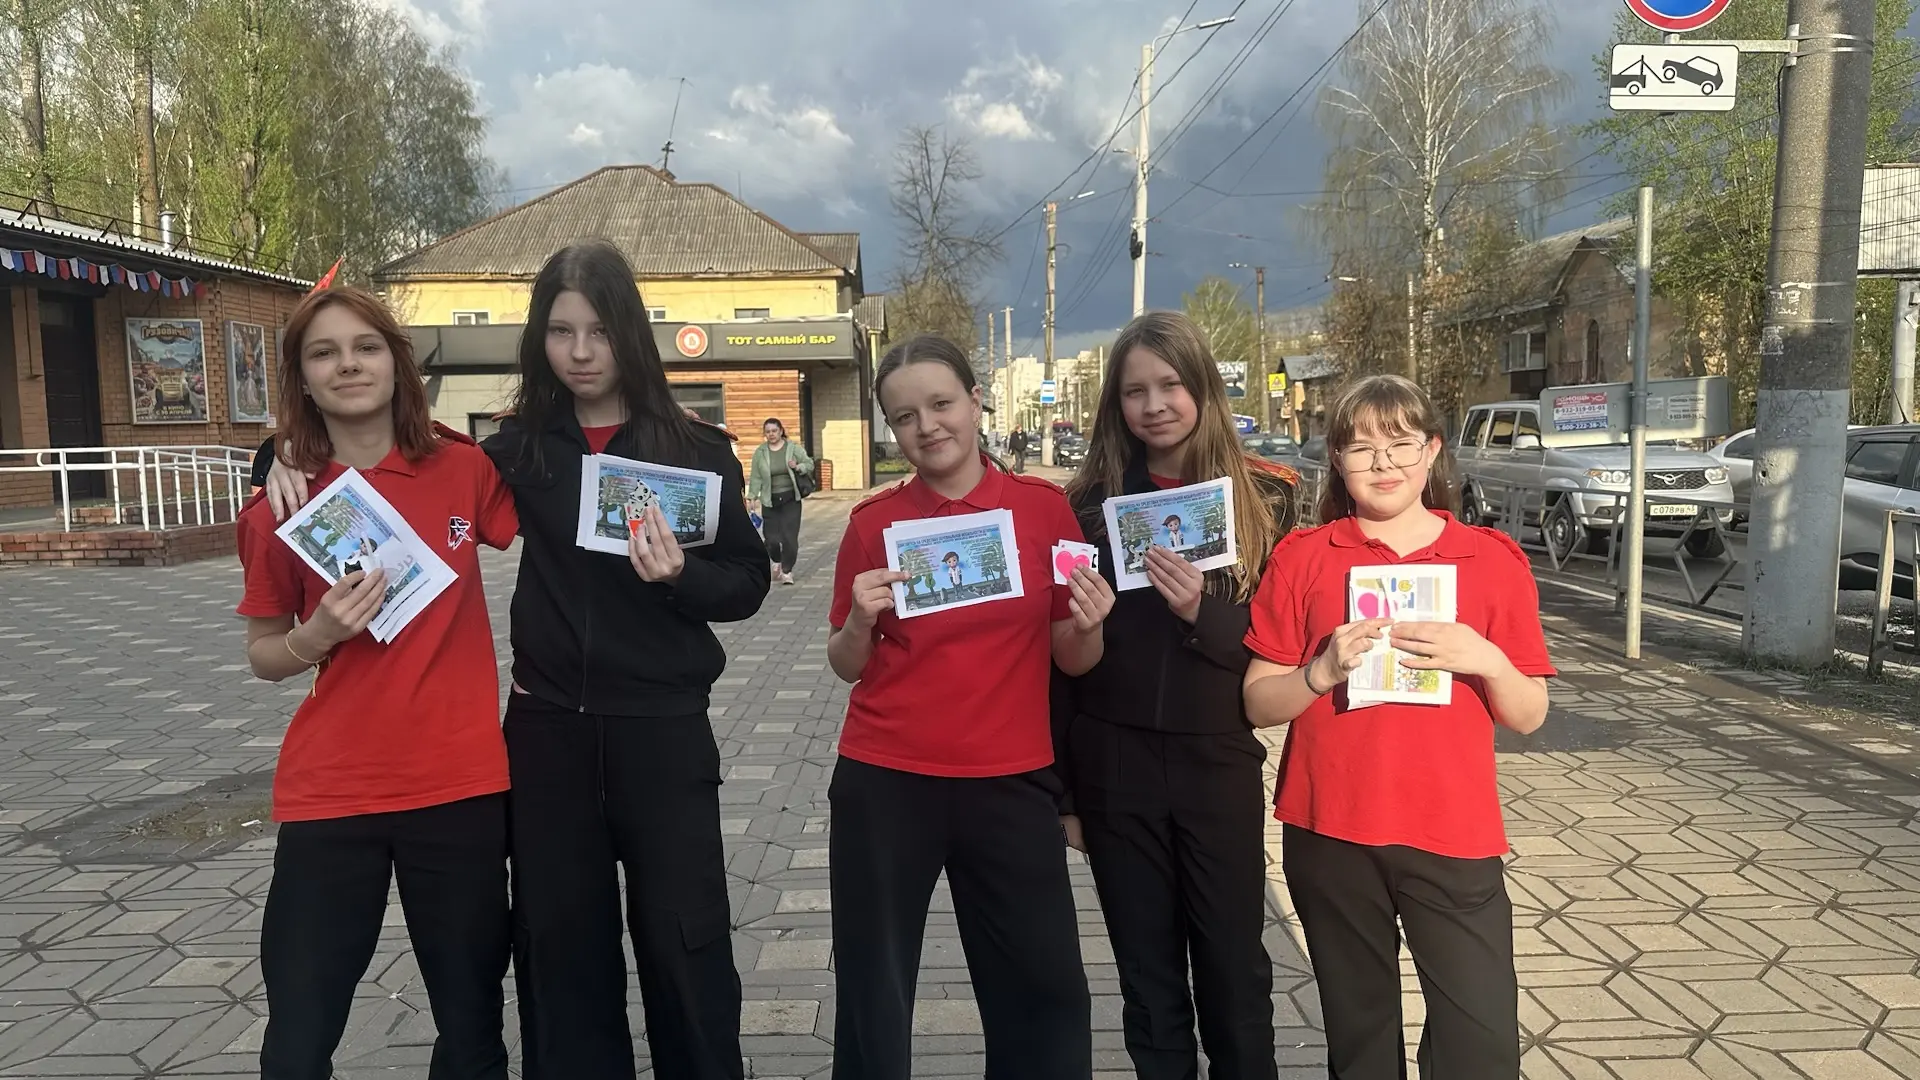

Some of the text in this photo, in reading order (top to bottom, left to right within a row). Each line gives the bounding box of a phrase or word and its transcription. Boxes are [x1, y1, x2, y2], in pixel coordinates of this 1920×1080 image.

[726, 334, 836, 346] ТОТ САМЫЙ БАР
